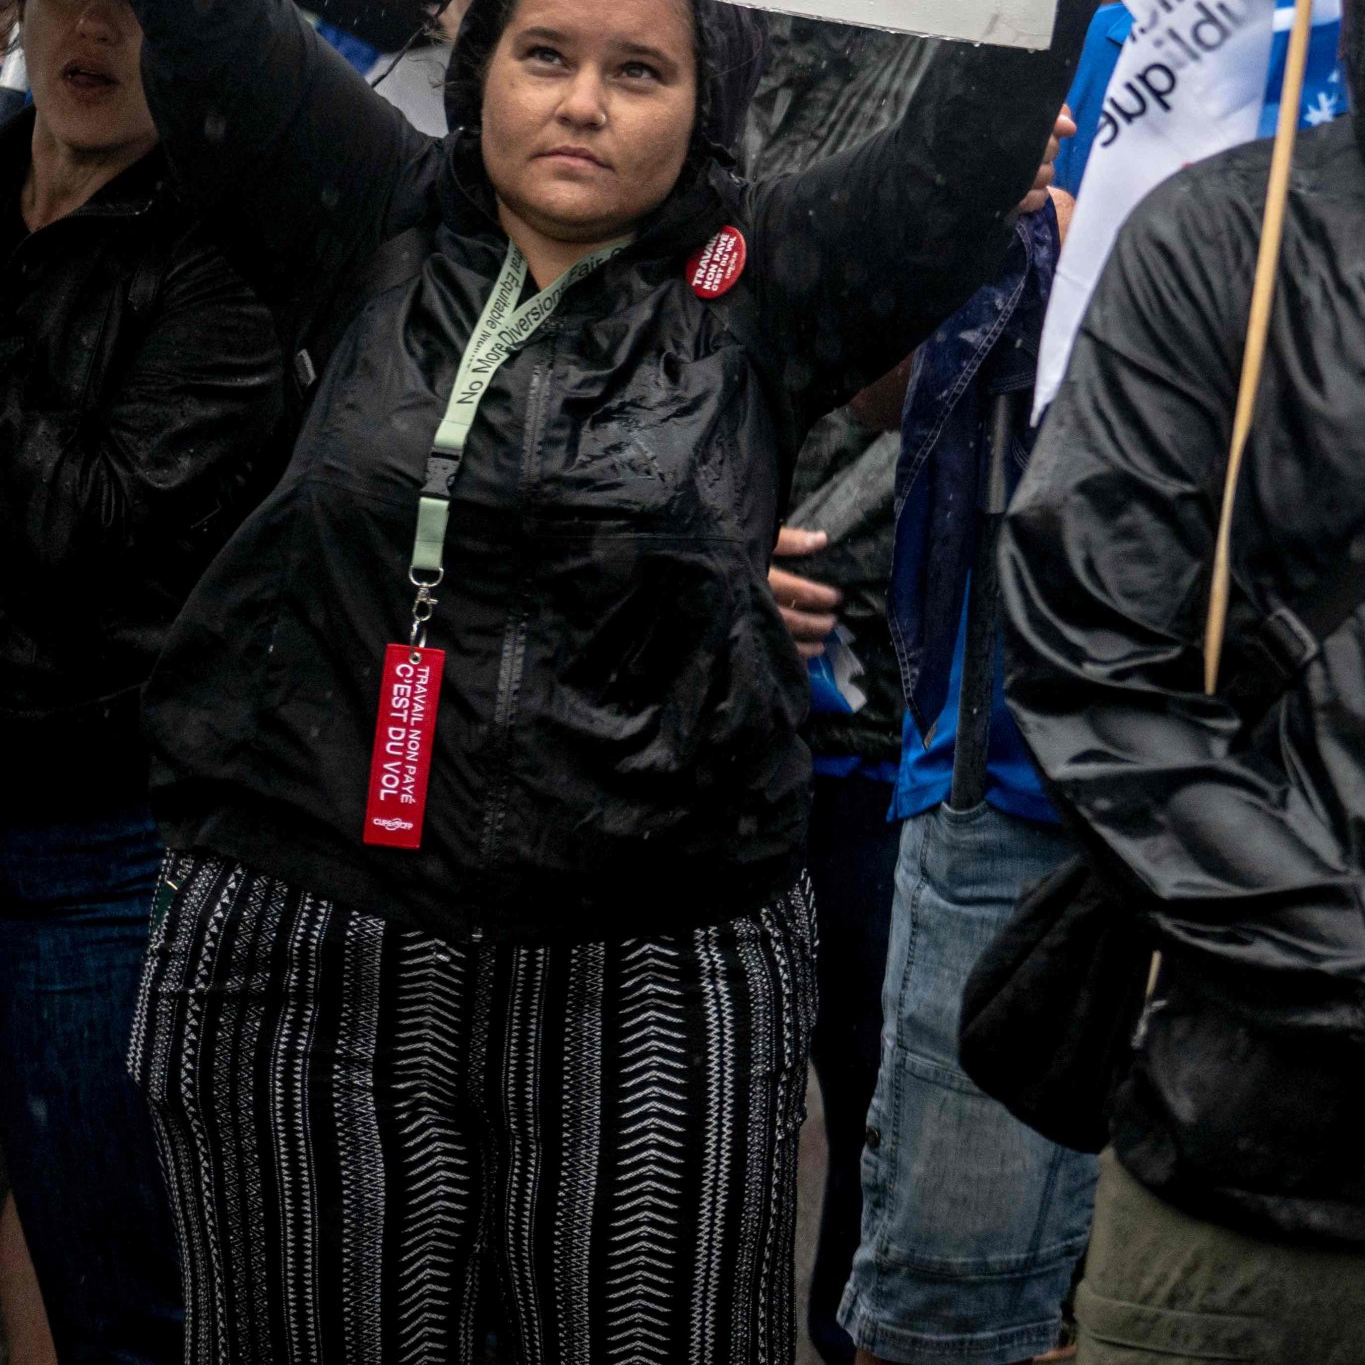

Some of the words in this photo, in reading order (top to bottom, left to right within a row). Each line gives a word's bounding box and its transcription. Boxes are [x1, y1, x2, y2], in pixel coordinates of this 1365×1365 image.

[703, 264, 718, 290] NON
[457, 380, 483, 405] No
[472, 343, 509, 374] More
[390, 663, 414, 723] C'EST
[410, 666, 430, 726] TRAVAIL
[385, 727, 406, 755] DU
[407, 730, 422, 762] NON
[379, 760, 402, 801] VOL
[400, 765, 417, 804] PAYÉ
